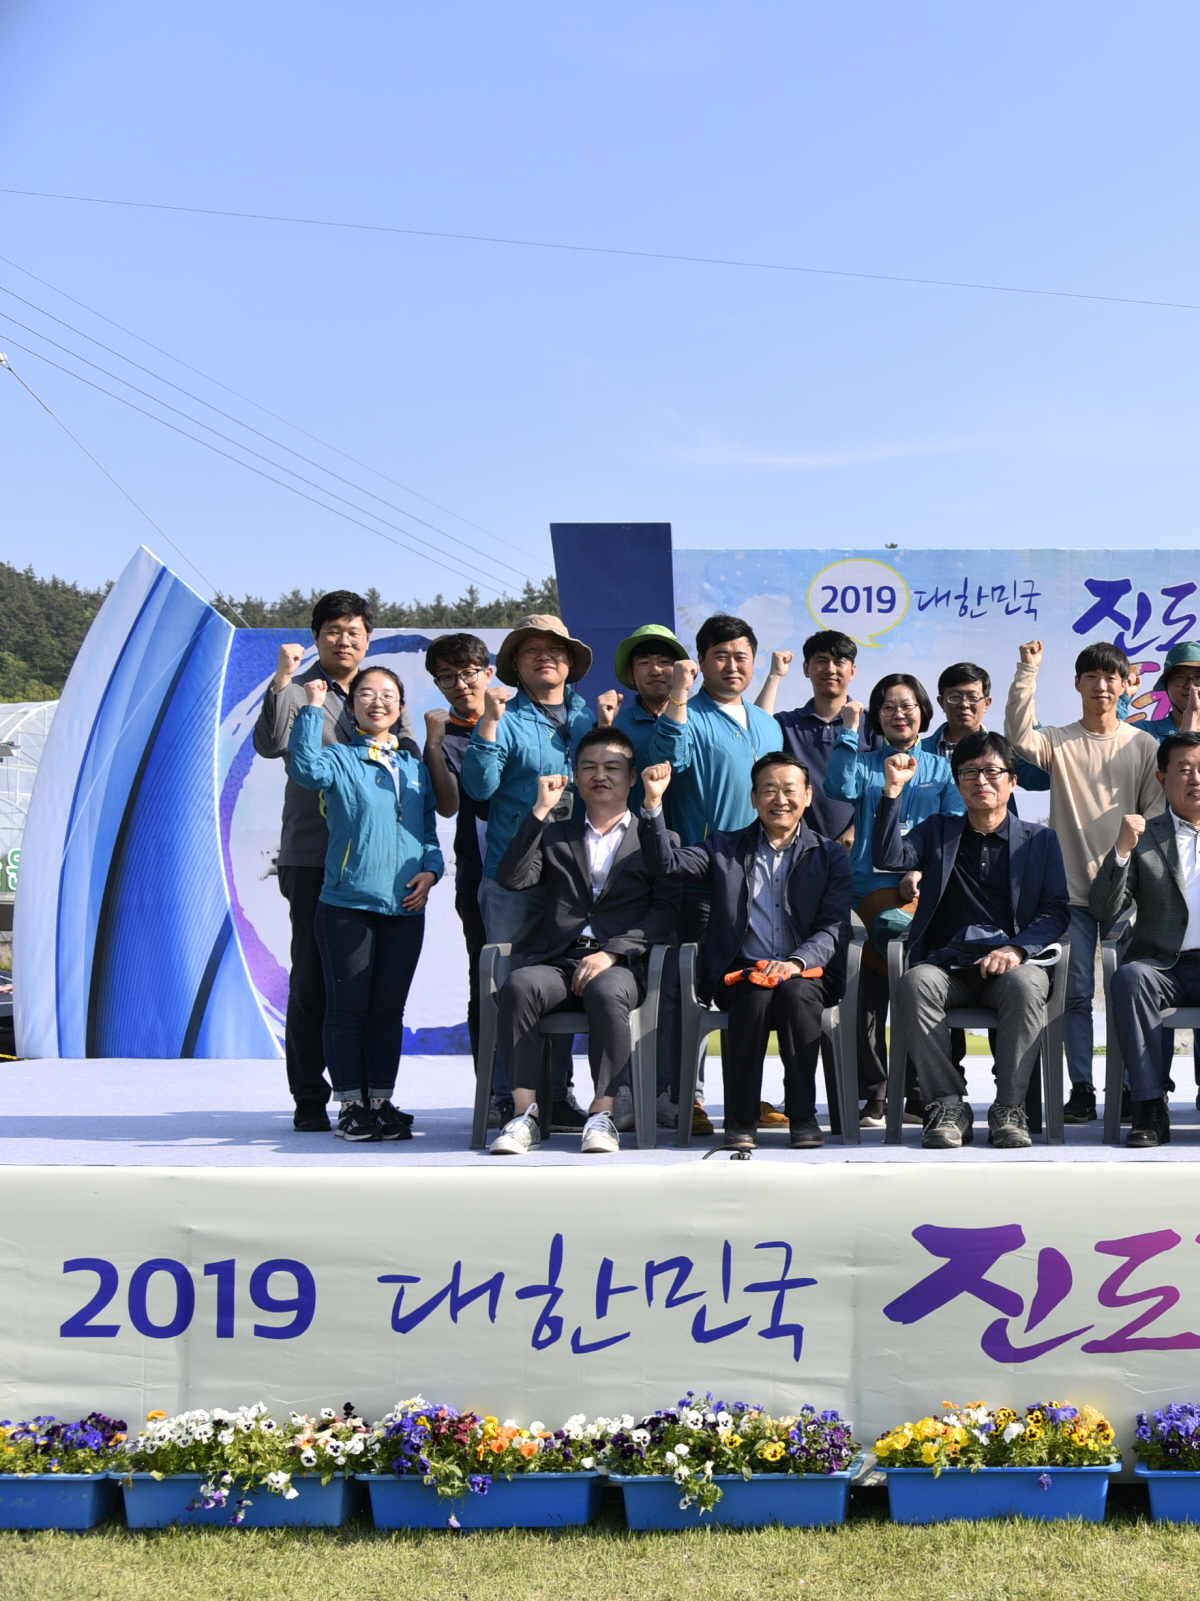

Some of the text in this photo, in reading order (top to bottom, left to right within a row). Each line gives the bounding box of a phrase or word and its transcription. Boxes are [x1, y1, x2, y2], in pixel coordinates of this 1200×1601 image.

[820, 585, 897, 614] 2019
[913, 576, 1042, 622] 대한민국
[59, 1257, 317, 1340] 2019
[376, 1232, 819, 1363] 대한민국
